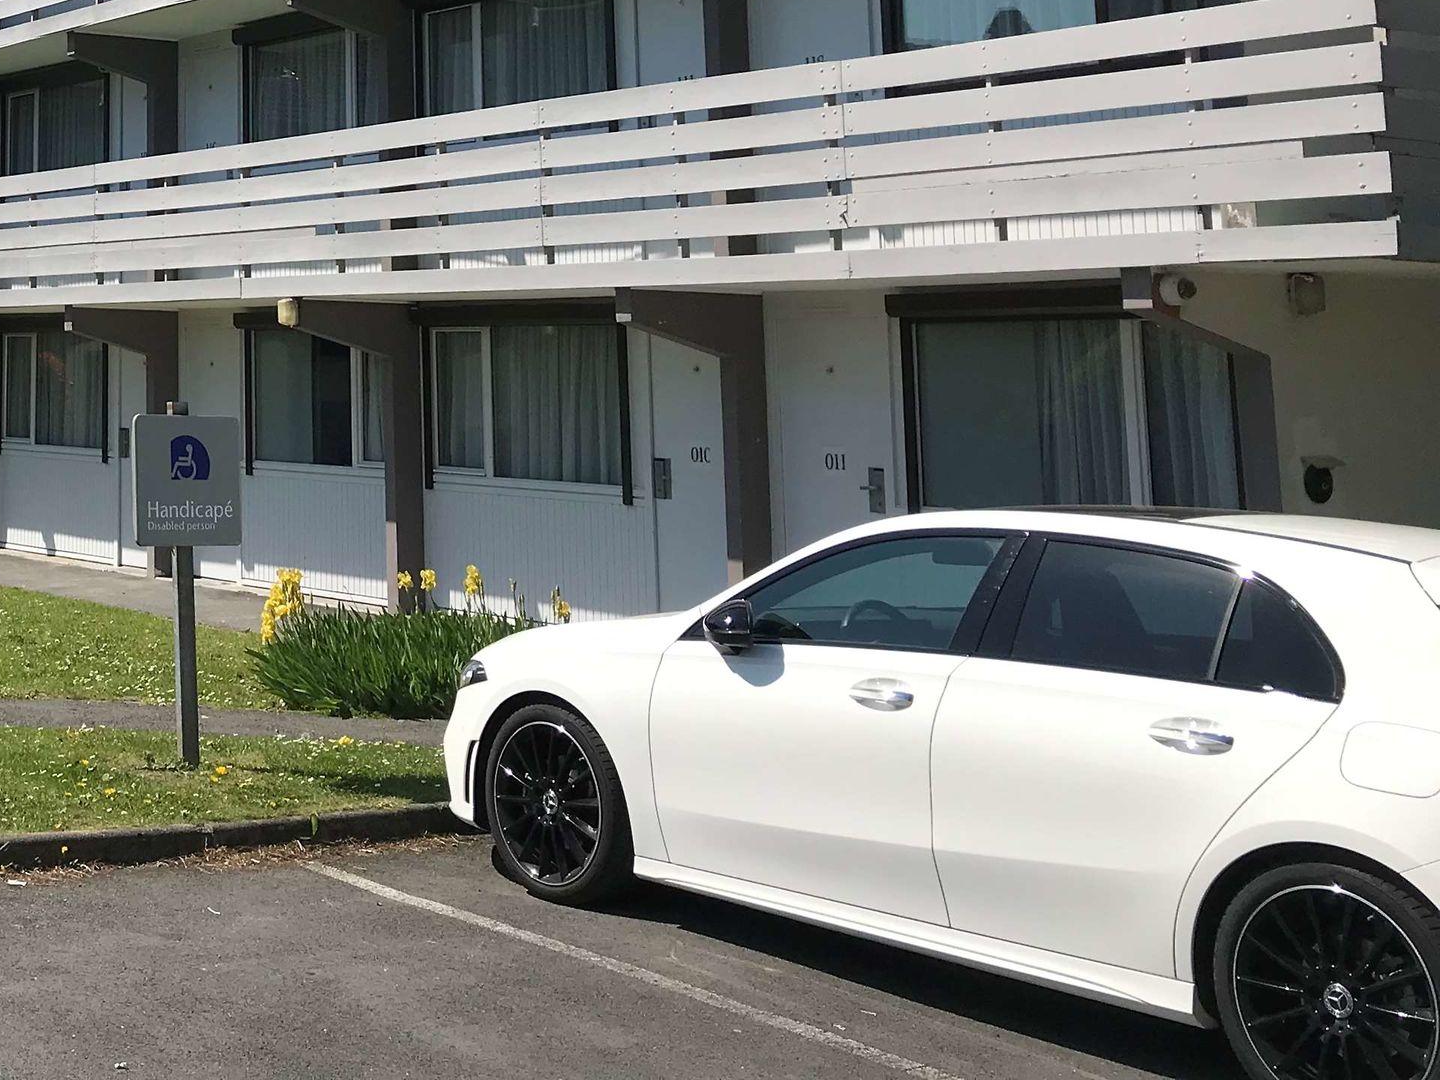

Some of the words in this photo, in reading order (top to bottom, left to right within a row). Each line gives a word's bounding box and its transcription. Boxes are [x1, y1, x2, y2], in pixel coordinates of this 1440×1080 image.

[825, 453, 846, 470] 011
[147, 500, 233, 523] Handicapé
[147, 520, 185, 531] Disabled
[186, 522, 216, 532] person
